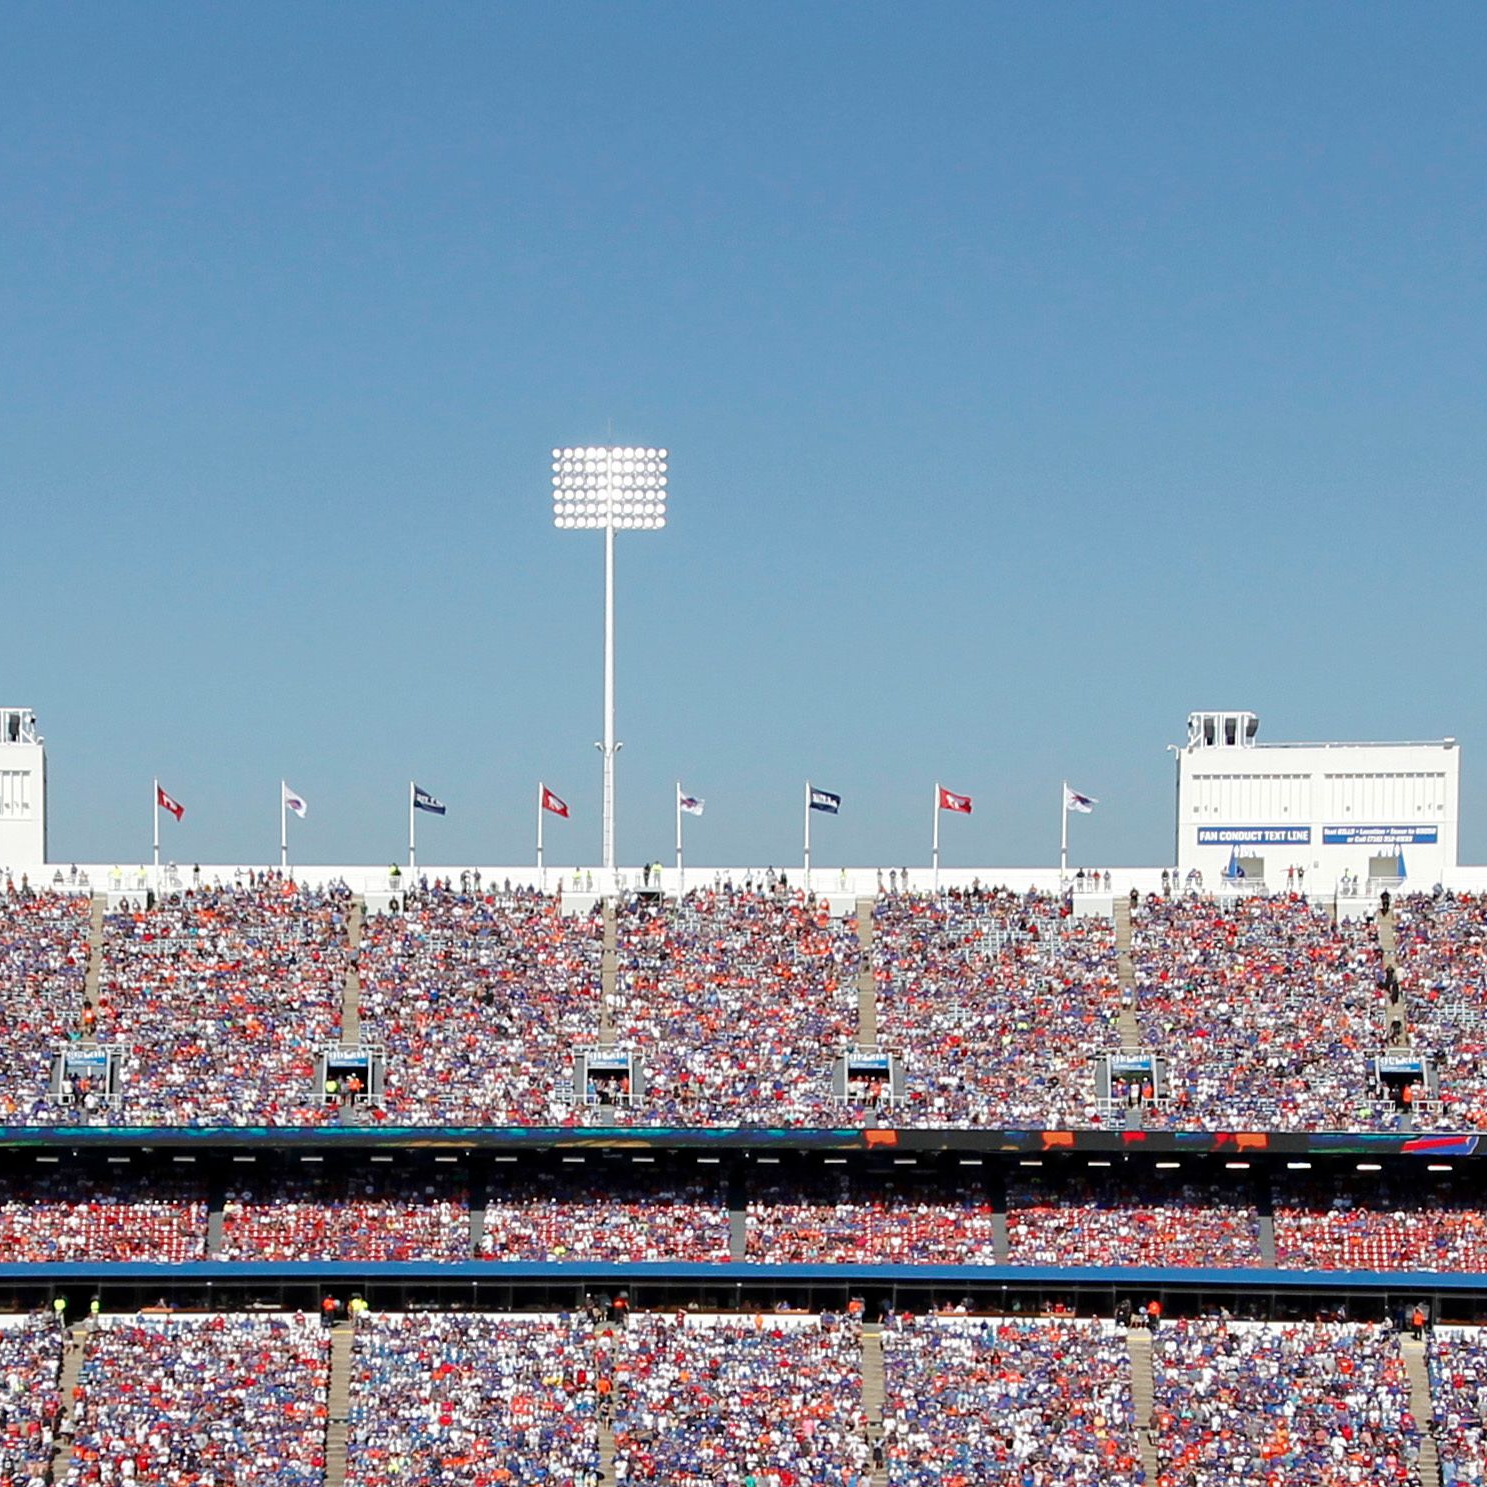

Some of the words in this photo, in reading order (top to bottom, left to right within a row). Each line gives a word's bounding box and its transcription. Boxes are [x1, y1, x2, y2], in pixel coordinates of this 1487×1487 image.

[1199, 830, 1219, 842] FAN
[1220, 830, 1263, 842] CONDUCT
[1264, 829, 1286, 842] TEXT
[1287, 829, 1310, 842] LINE
